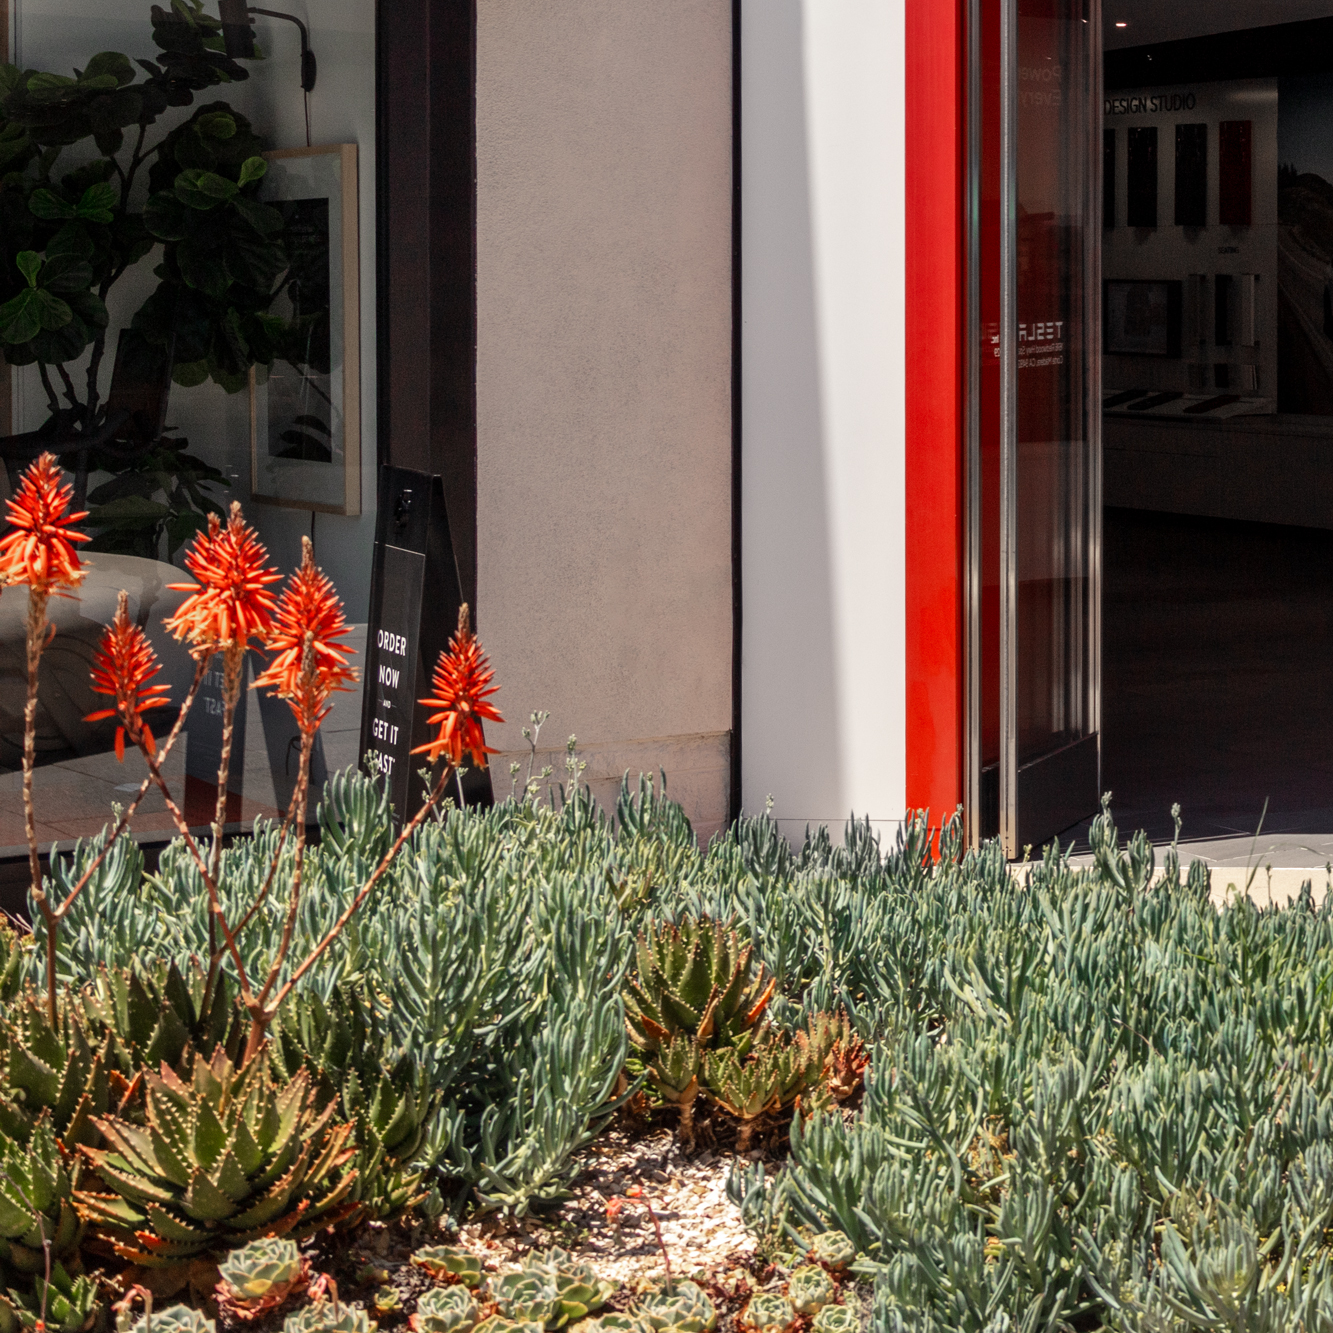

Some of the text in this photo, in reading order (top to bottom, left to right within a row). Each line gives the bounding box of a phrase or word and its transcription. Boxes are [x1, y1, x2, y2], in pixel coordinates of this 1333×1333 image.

[1103, 93, 1196, 115] DESIGN STUDIO
[377, 629, 407, 656] ORDER
[378, 664, 400, 689] NOW
[382, 699, 392, 709] AND
[372, 718, 399, 746] GET IT
